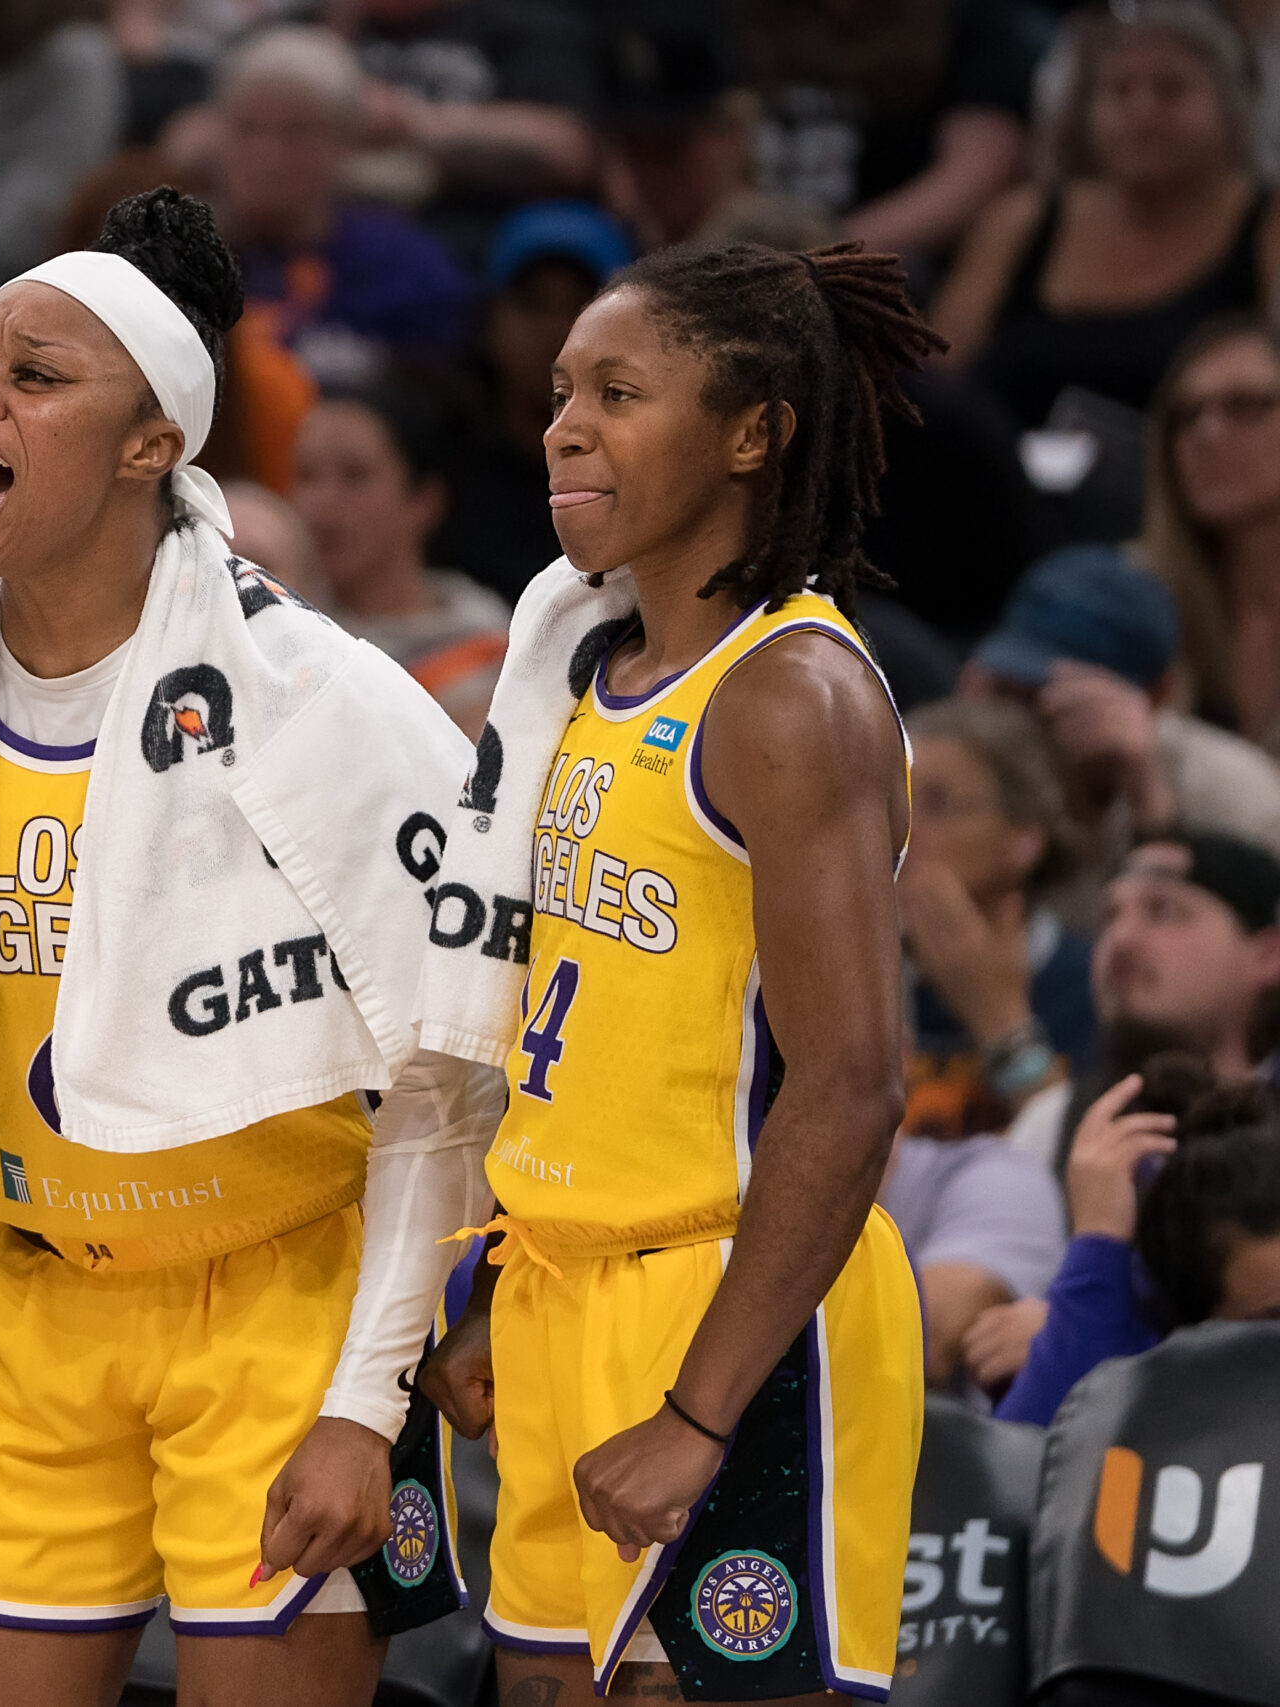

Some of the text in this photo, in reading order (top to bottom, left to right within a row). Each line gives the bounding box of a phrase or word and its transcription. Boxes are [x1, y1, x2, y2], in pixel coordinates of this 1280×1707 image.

[649, 721, 676, 743] UCLA
[630, 748, 669, 776] Health
[537, 752, 615, 839] LOS
[532, 832, 678, 954] GELES
[167, 933, 352, 1037] GAT
[518, 948, 581, 1104] 4
[40, 1173, 224, 1221] EquiTrust
[700, 1576, 718, 1610] LOS
[724, 1560, 790, 1607] ANGELES
[712, 1627, 781, 1651] SPARKS
